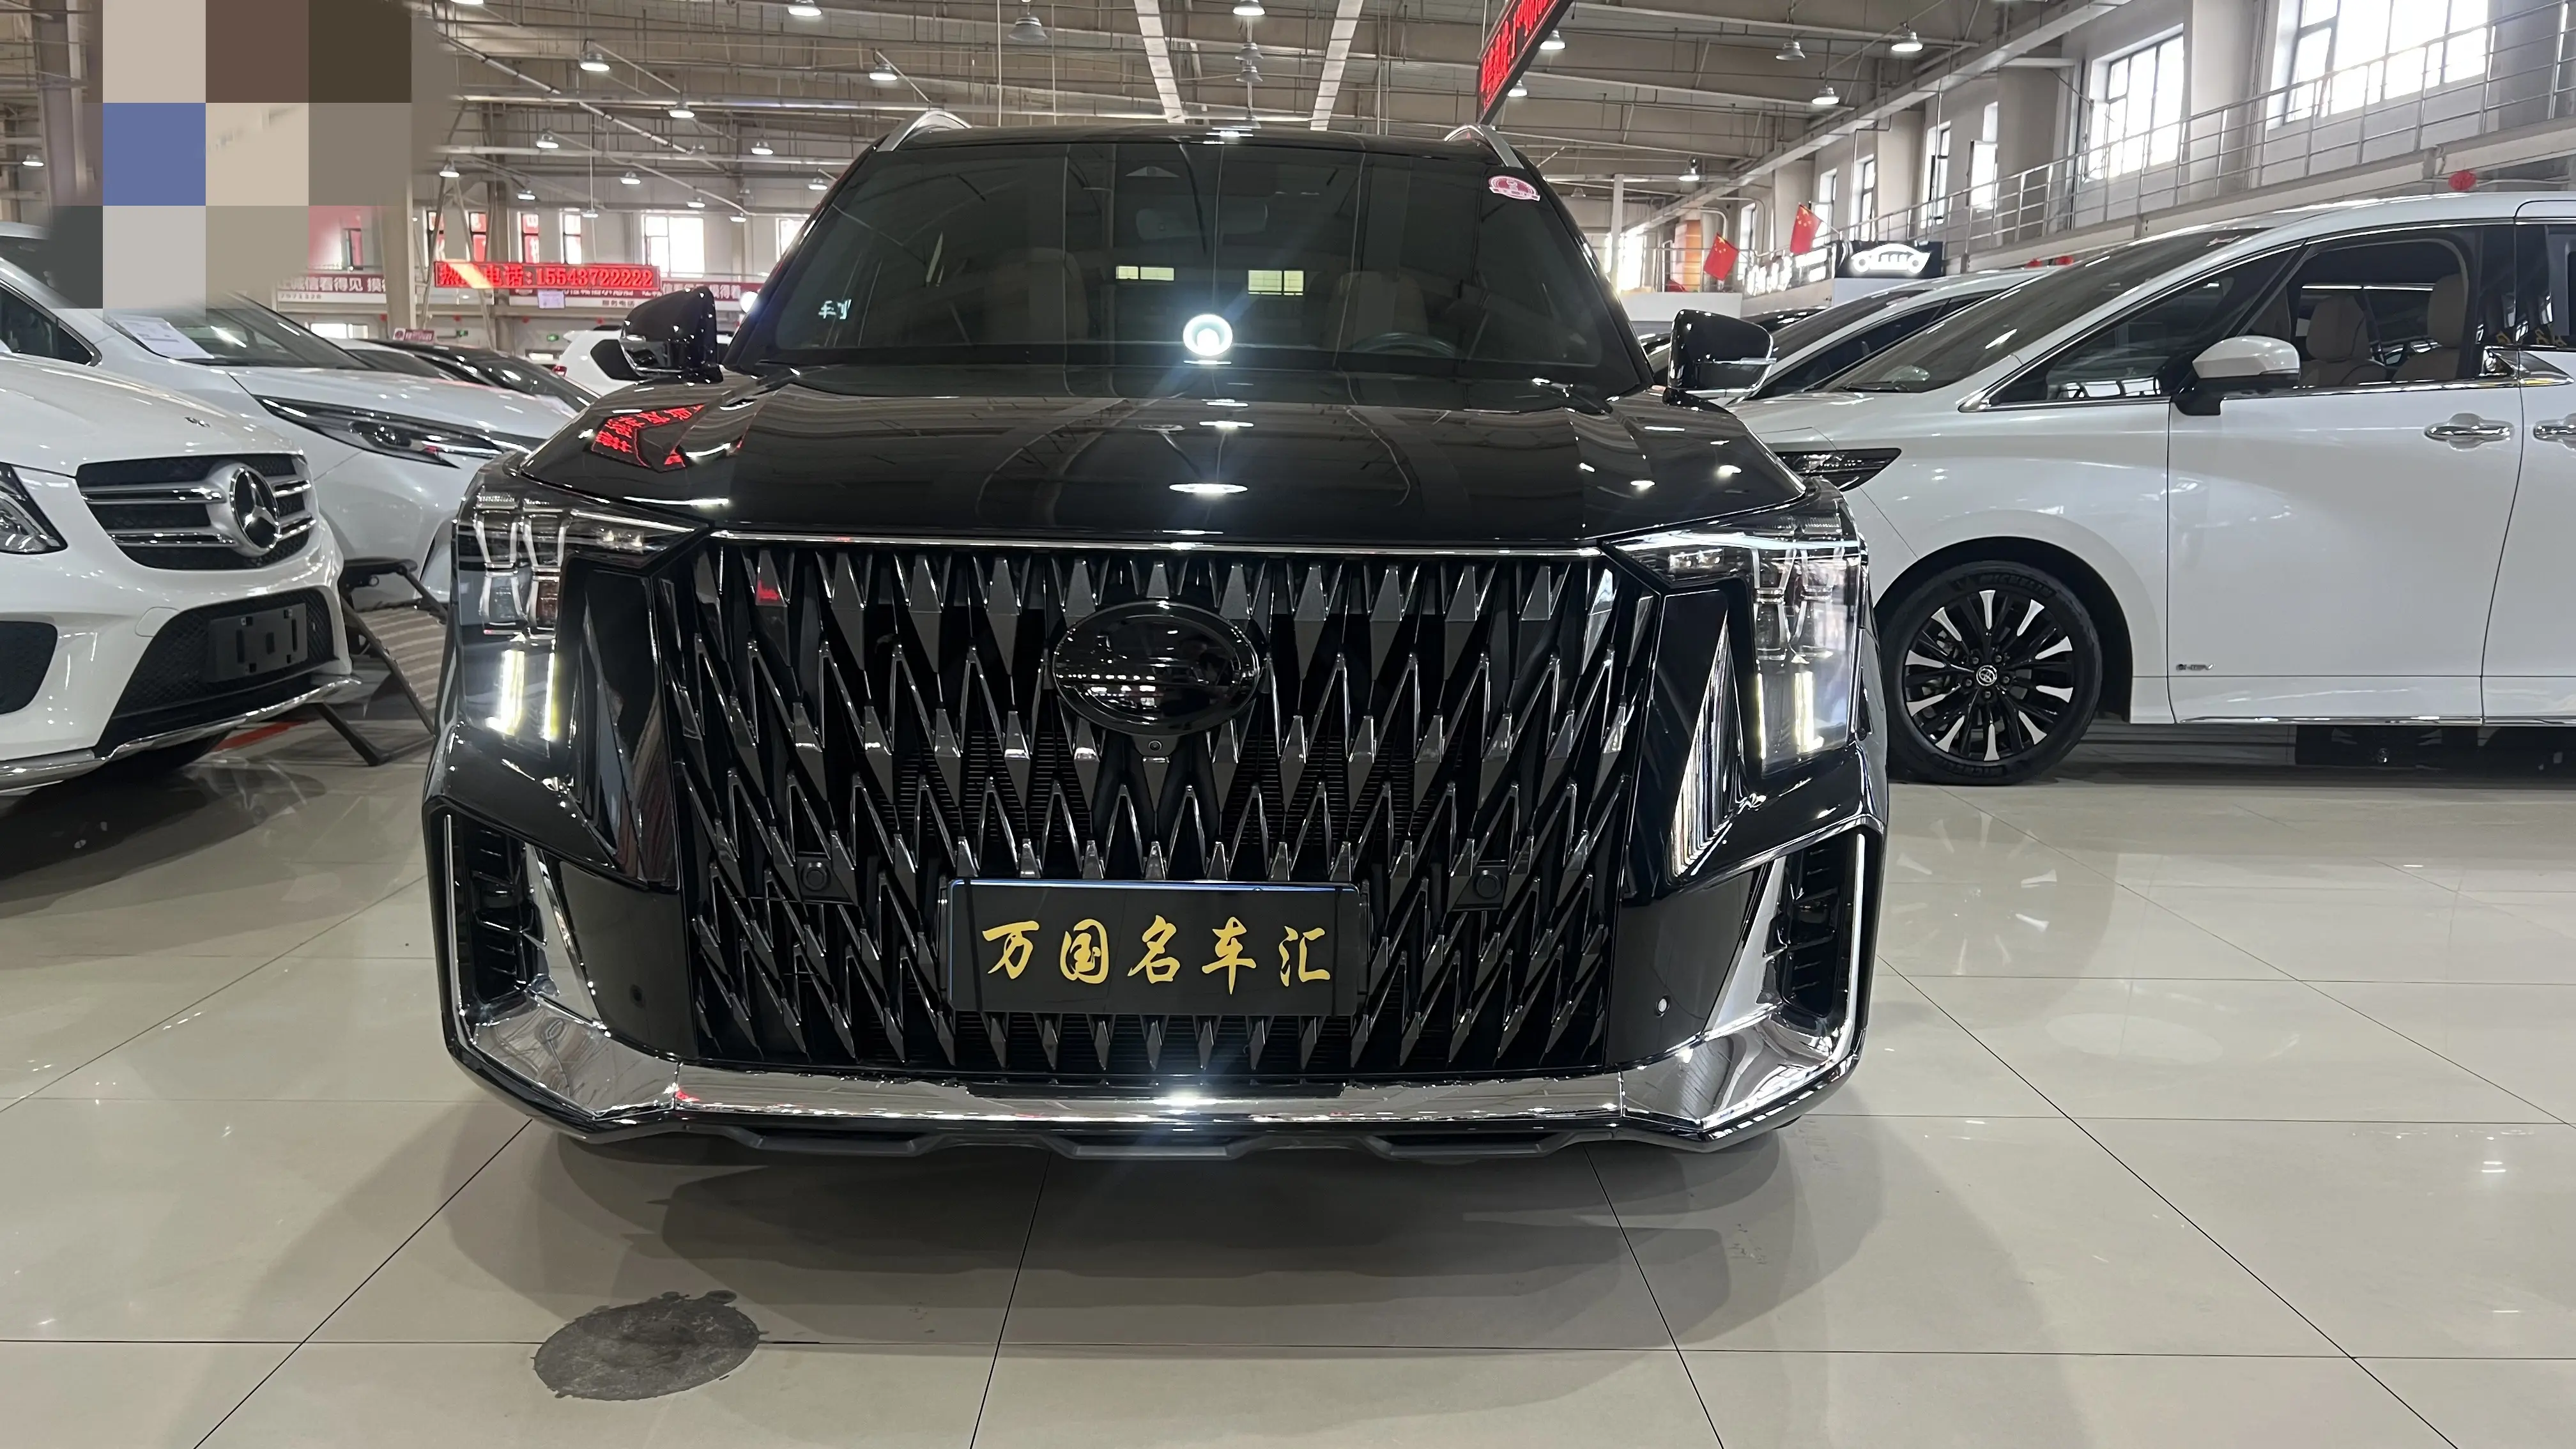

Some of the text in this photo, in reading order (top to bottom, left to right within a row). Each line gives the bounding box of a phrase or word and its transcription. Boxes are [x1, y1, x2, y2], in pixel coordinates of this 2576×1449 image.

[367, 277, 386, 292] 摸
[440, 263, 654, 287] 热电话:15543722222
[982, 915, 1330, 995] 万国名车汇
